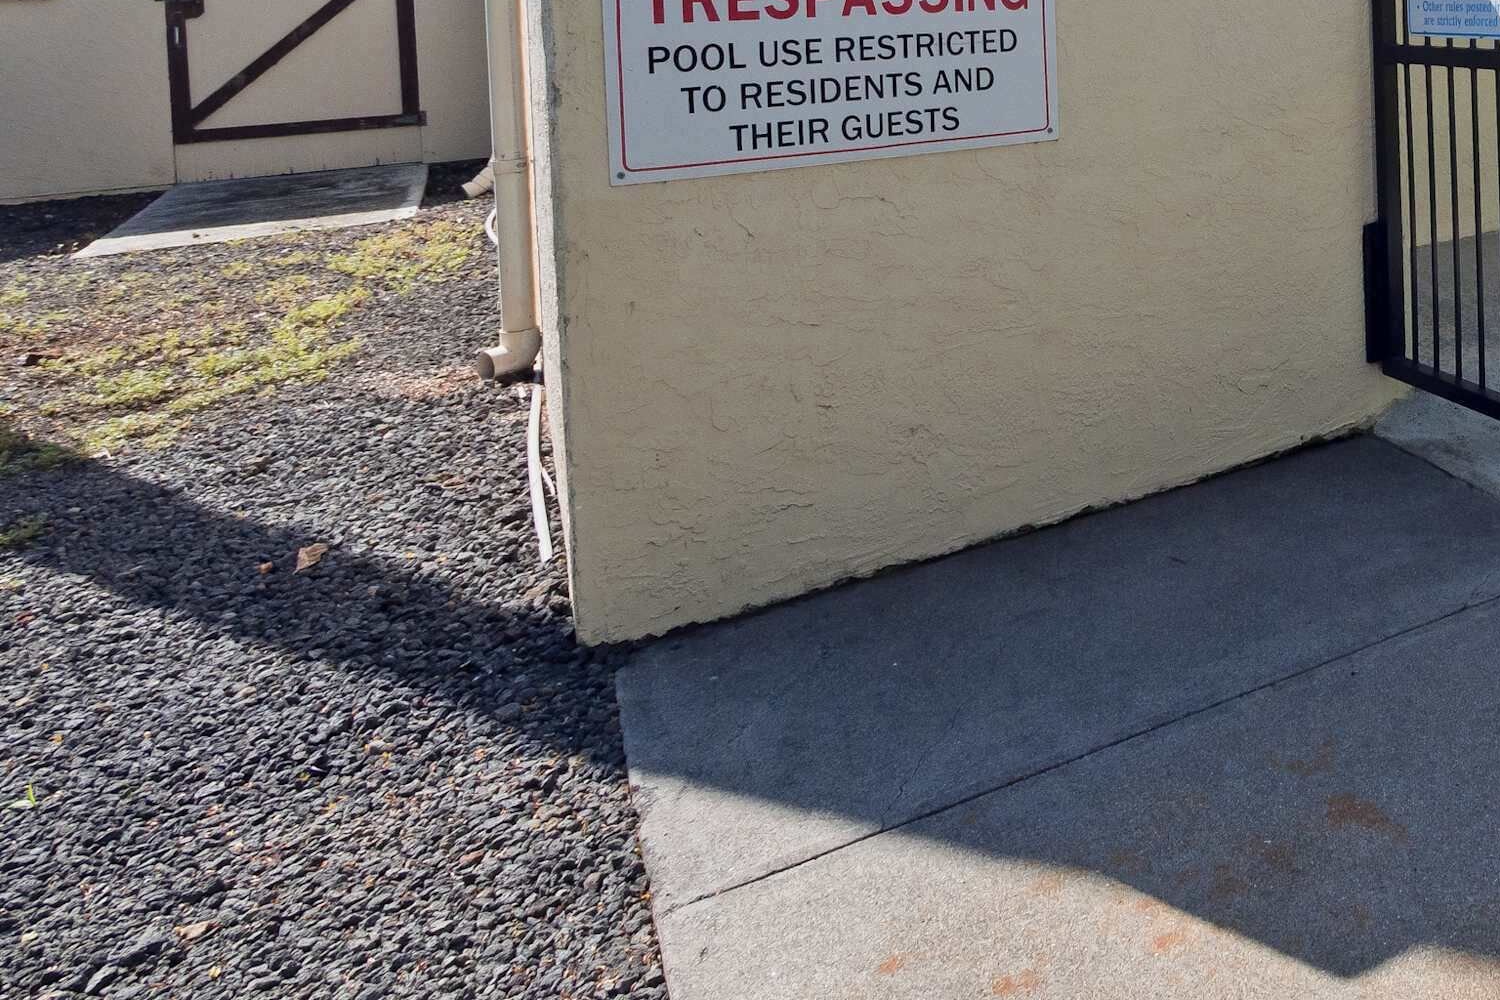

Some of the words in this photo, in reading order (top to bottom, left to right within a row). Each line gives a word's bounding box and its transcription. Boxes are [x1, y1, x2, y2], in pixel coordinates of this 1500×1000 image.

[1422, 0, 1443, 12] Other
[1445, 0, 1464, 12] rules
[1466, 1, 1492, 15] posted
[1424, 17, 1434, 26] are
[1437, 16, 1462, 28] strictly
[1464, 15, 1498, 26] enforced
[648, 43, 747, 74] POOL
[758, 38, 823, 67] USE
[835, 28, 1018, 62] RESTRICTED
[681, 85, 726, 114] TO
[740, 72, 923, 110] RESIDENTS
[933, 67, 995, 95] AND
[729, 117, 829, 151] THEIR
[841, 106, 961, 141] GUESTS
